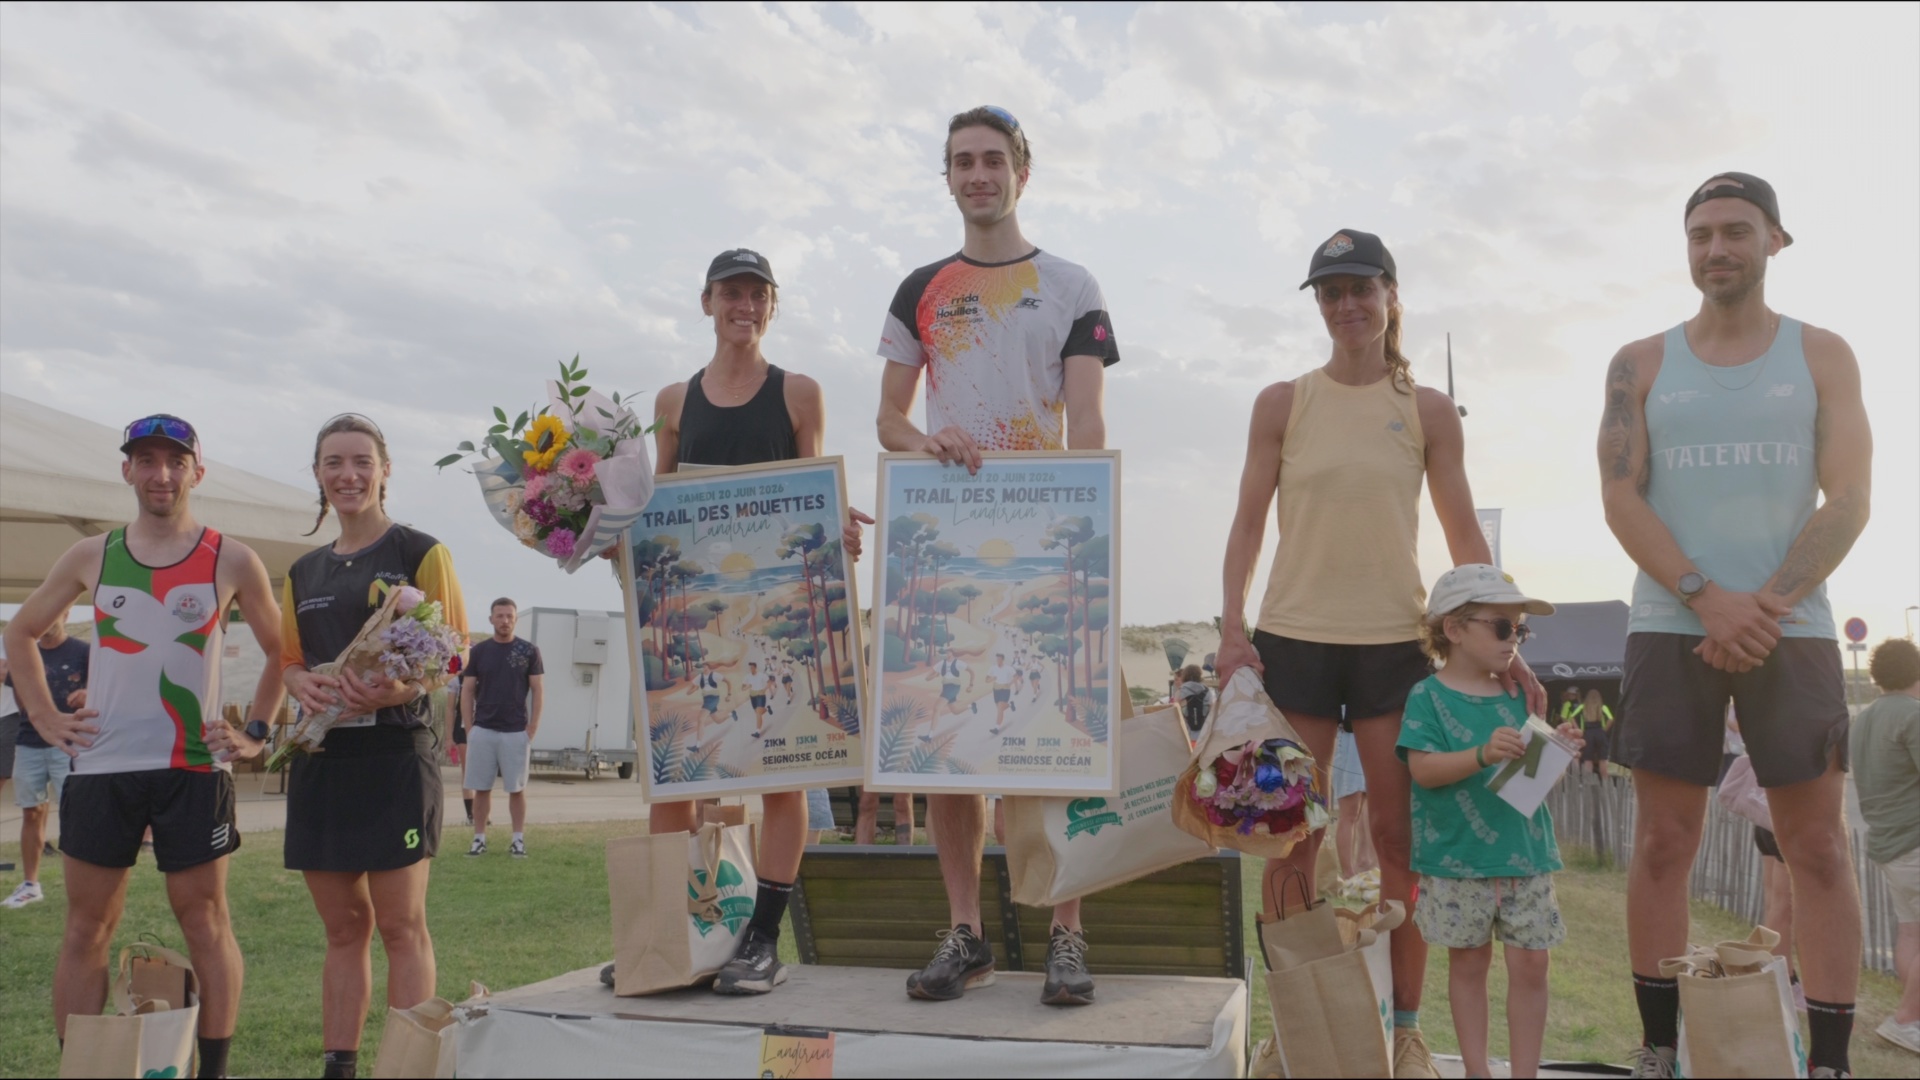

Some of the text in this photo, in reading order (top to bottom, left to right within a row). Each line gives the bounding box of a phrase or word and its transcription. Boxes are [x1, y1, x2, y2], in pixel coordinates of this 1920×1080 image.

[936, 306, 979, 319] Houilles
[1664, 443, 1798, 470] VALENCIA
[942, 472, 1056, 483] SAMEDI 20 JUIN 2026
[677, 484, 785, 504] SAMEDI 20 JUIN 2026
[903, 487, 1097, 504] TRAIL DES MOUETTES
[643, 494, 825, 528] TRAIL DES MOUETTES
[953, 495, 1038, 526] Landirun
[692, 515, 771, 545] Landirun
[764, 738, 786, 748] 21KM
[796, 735, 818, 745] 13KM
[1002, 737, 1026, 746] 21KM
[1037, 737, 1061, 747] 13KM
[762, 748, 848, 765] SEIGNOSSE OCÉAN
[998, 753, 1092, 766] SEIGNOSSE OCÉAN
[1120, 775, 1177, 799] JE RÉDUIS MES DÉCHETS
[1124, 802, 1131, 810] JE
[1131, 794, 1152, 808] RECYCLE
[1127, 813, 1135, 821] JE
[1135, 803, 1166, 817] CONSOMME
[763, 1035, 832, 1066] Landirun
